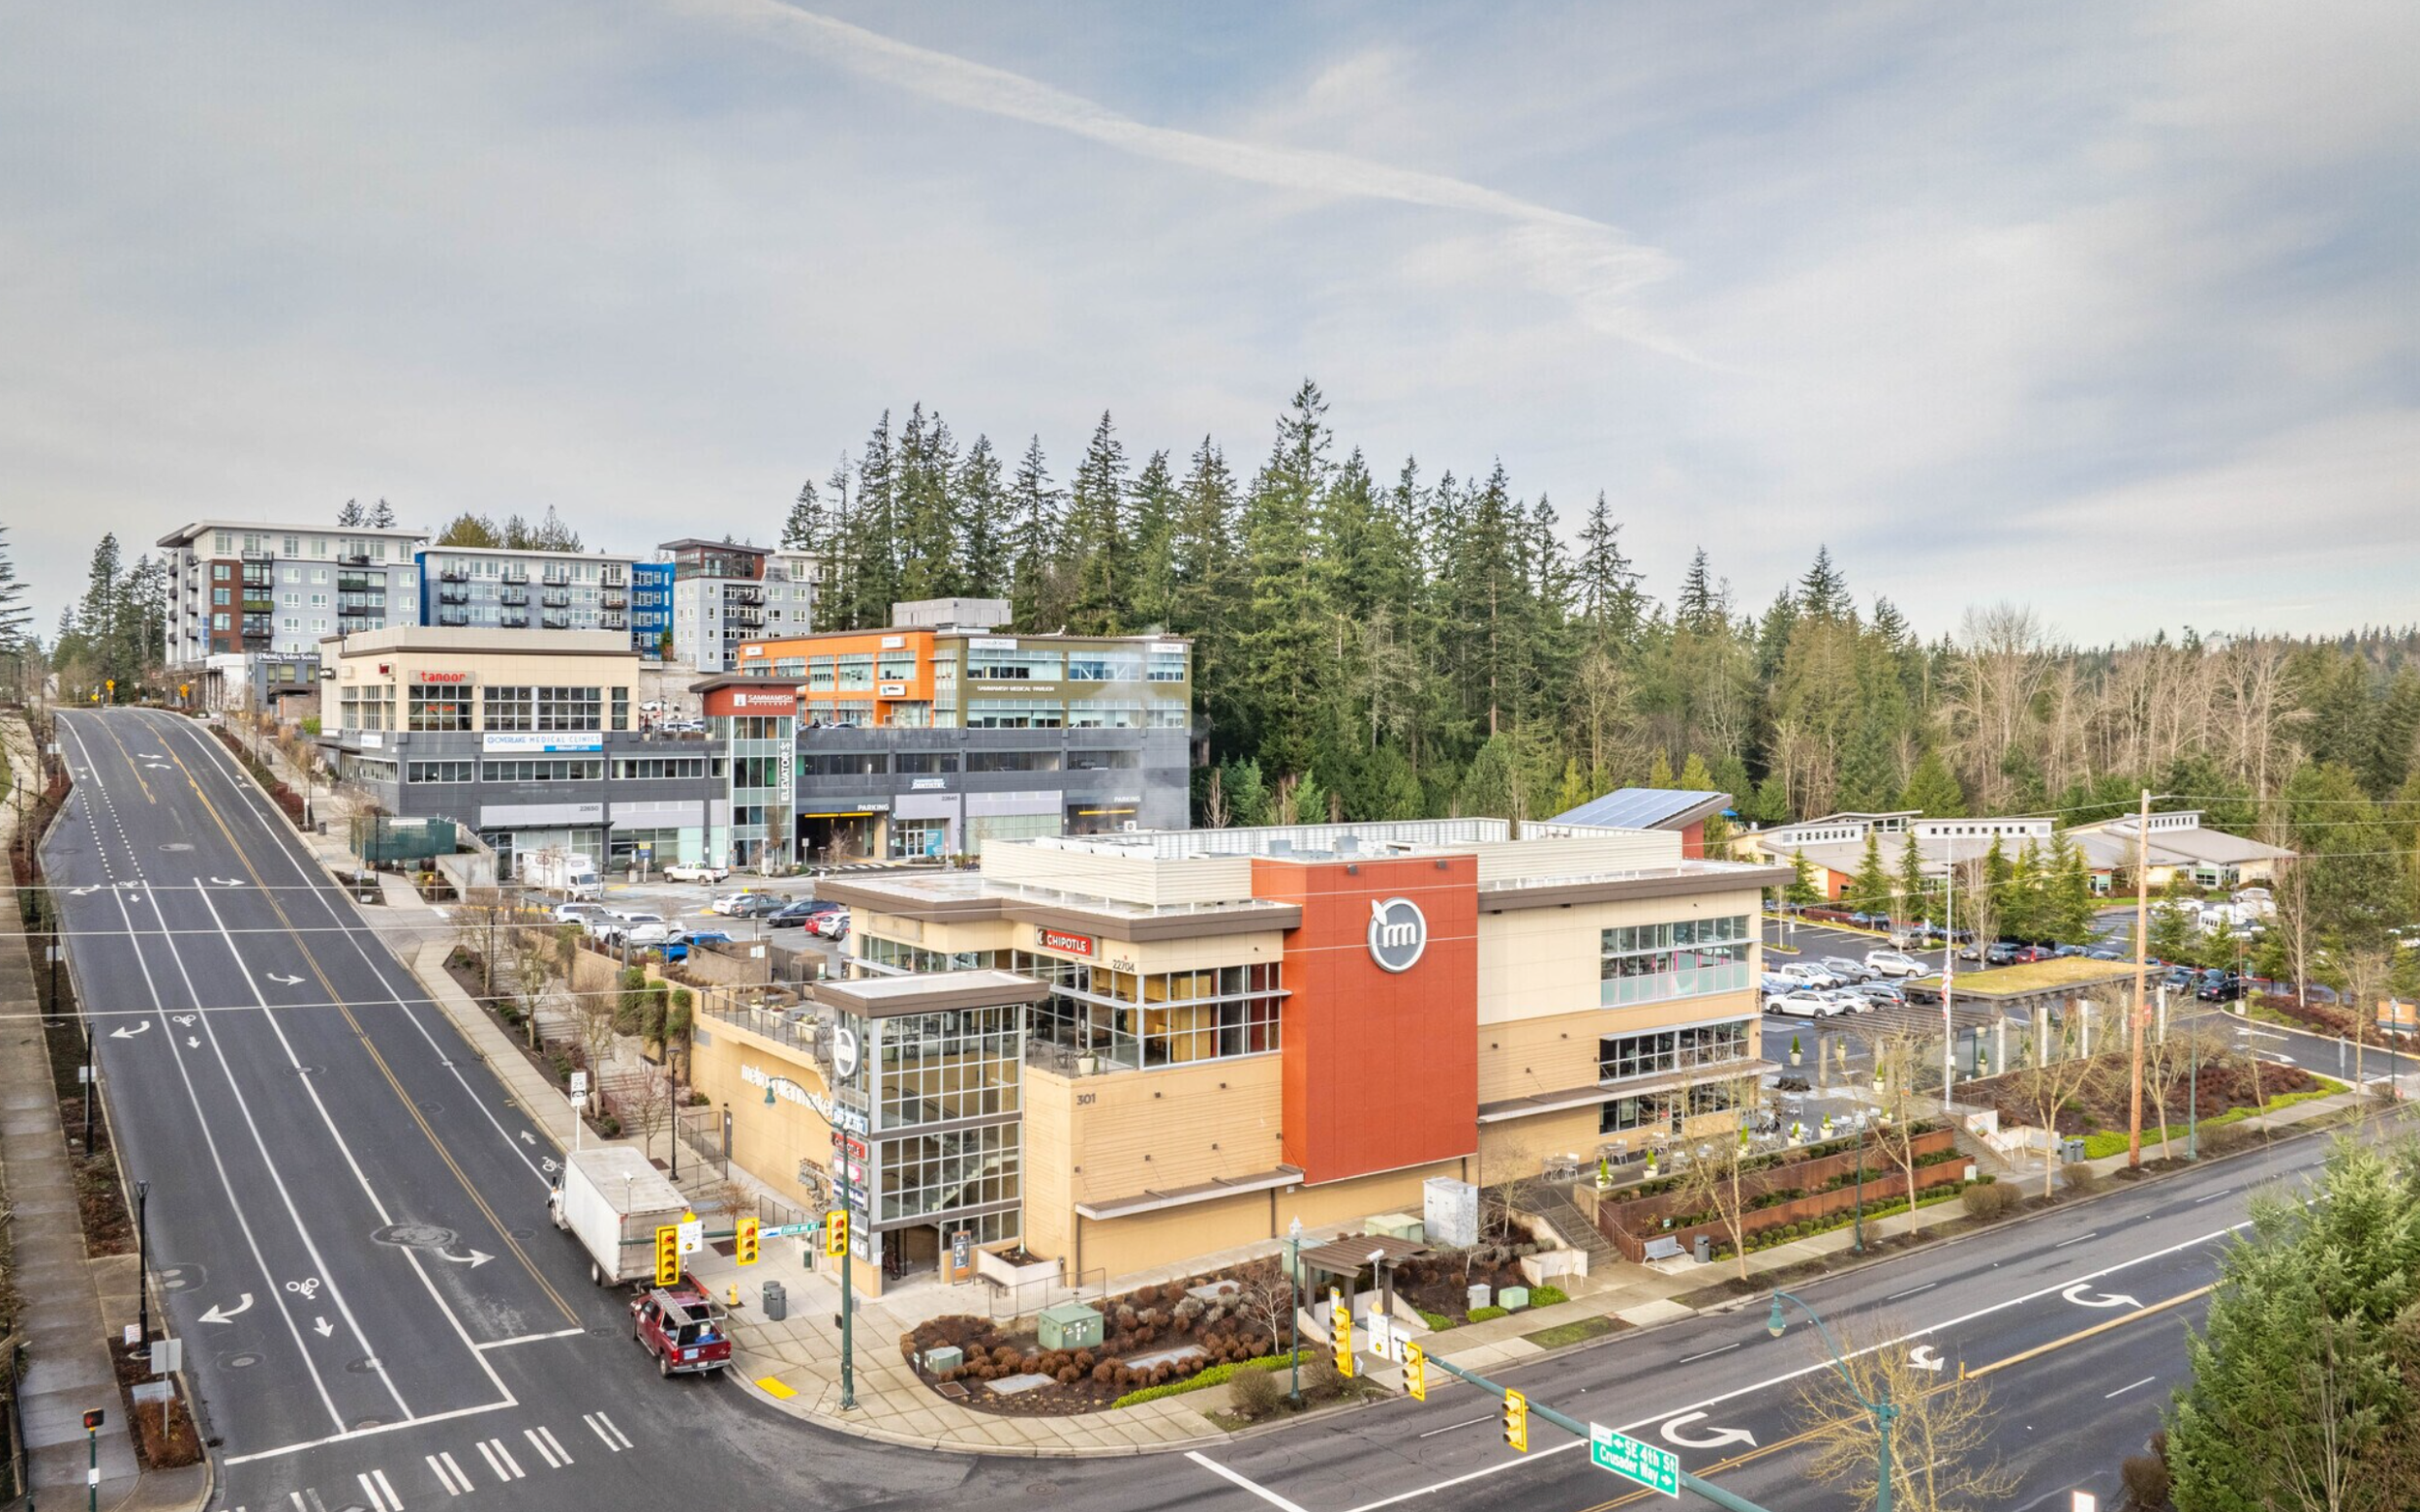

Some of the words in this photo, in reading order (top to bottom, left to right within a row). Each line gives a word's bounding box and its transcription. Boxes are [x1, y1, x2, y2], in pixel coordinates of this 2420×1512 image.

[420, 671, 466, 681] tanoor
[781, 751, 790, 801] ELEVATOR
[1046, 934, 1087, 953] CHIPOTLE
[1113, 959, 1135, 973] 22704
[1076, 1093, 1096, 1105] 301
[1599, 1444, 1638, 1474] Crusader
[1640, 1461, 1659, 1487] Way
[1624, 1439, 1639, 1459] SE
[1640, 1446, 1659, 1467] 4th
[1663, 1454, 1676, 1473] St
